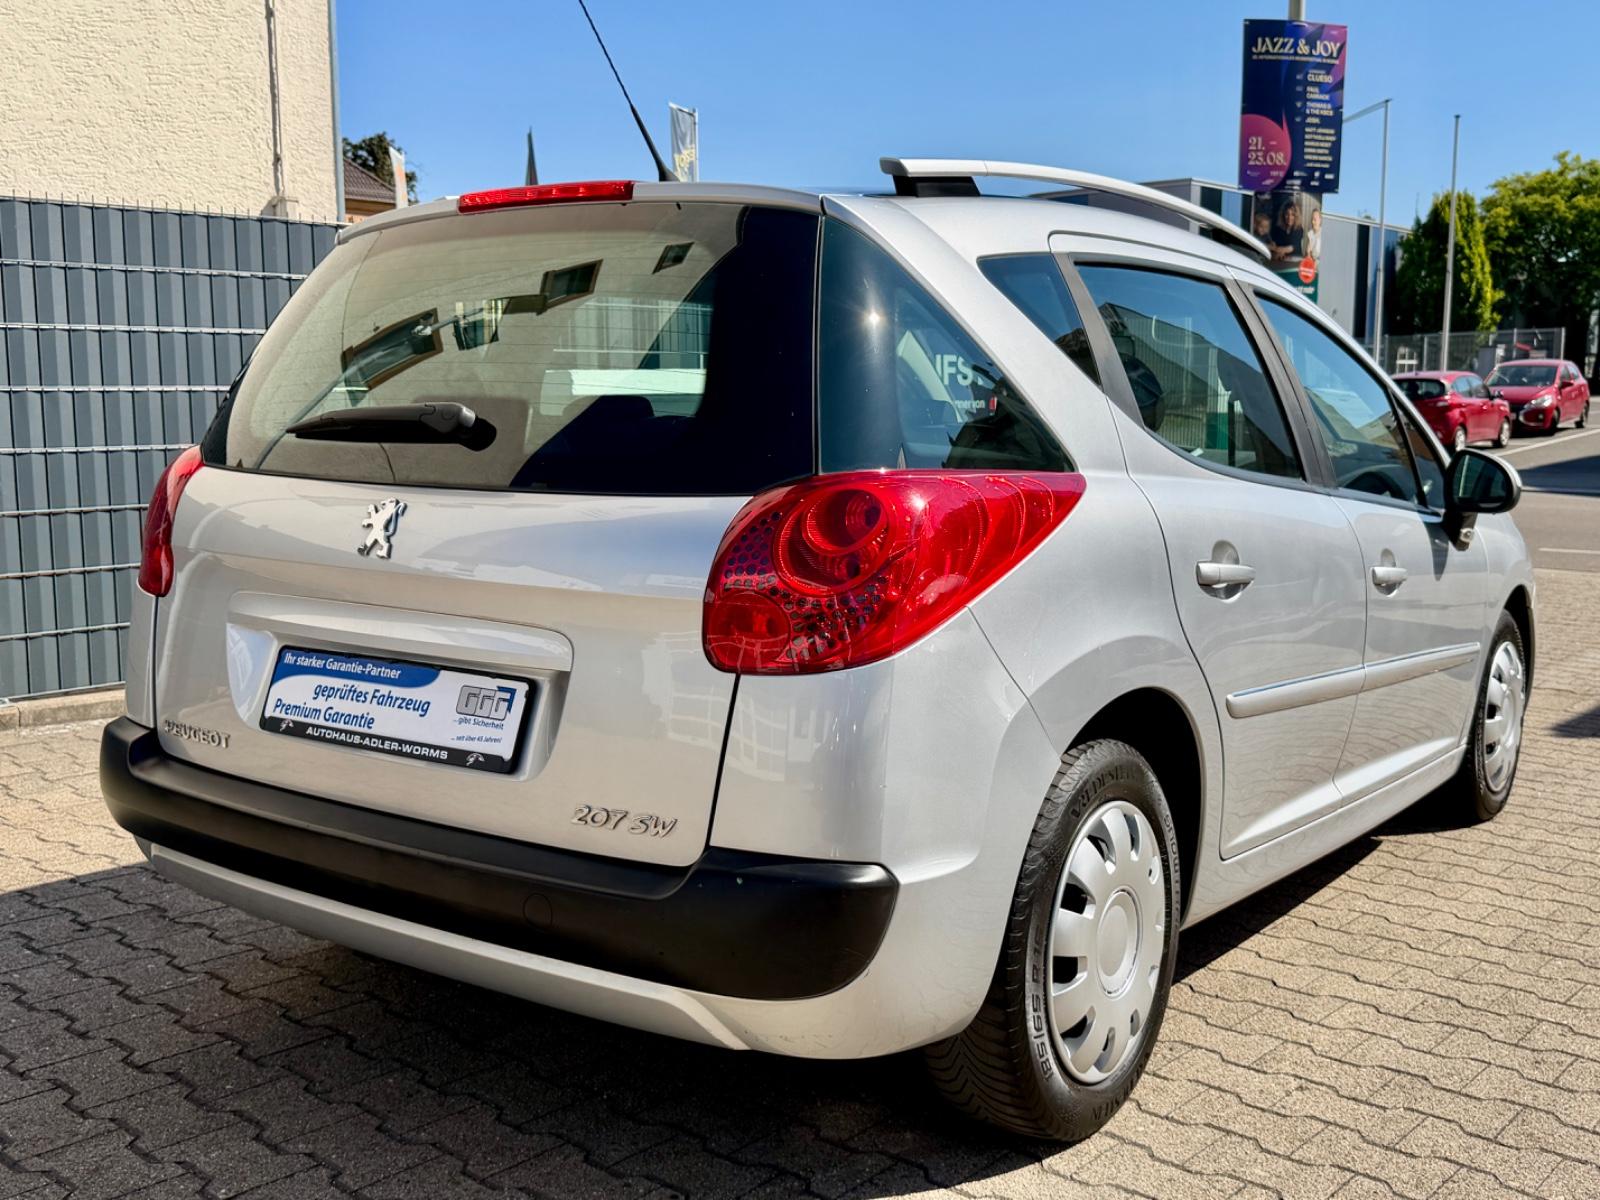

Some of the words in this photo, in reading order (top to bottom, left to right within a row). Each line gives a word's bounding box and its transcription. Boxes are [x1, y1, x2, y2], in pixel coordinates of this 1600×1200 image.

[1252, 37, 1294, 54] JAZZ
[1297, 39, 1310, 55] &
[1312, 40, 1341, 57] JOY
[1248, 136, 1265, 150] 21.
[284, 653, 297, 665] Ihr
[297, 655, 325, 669] starker
[326, 658, 402, 679] Garantie-Partner
[273, 698, 322, 720] Premium
[323, 706, 376, 729] Garantie
[312, 684, 370, 703] geprüftes
[370, 688, 432, 717] Fahrzeug
[164, 719, 231, 748] PEUGEOT
[473, 718, 504, 730] Sicherheit
[572, 804, 629, 831] 207
[628, 814, 679, 839] SW
